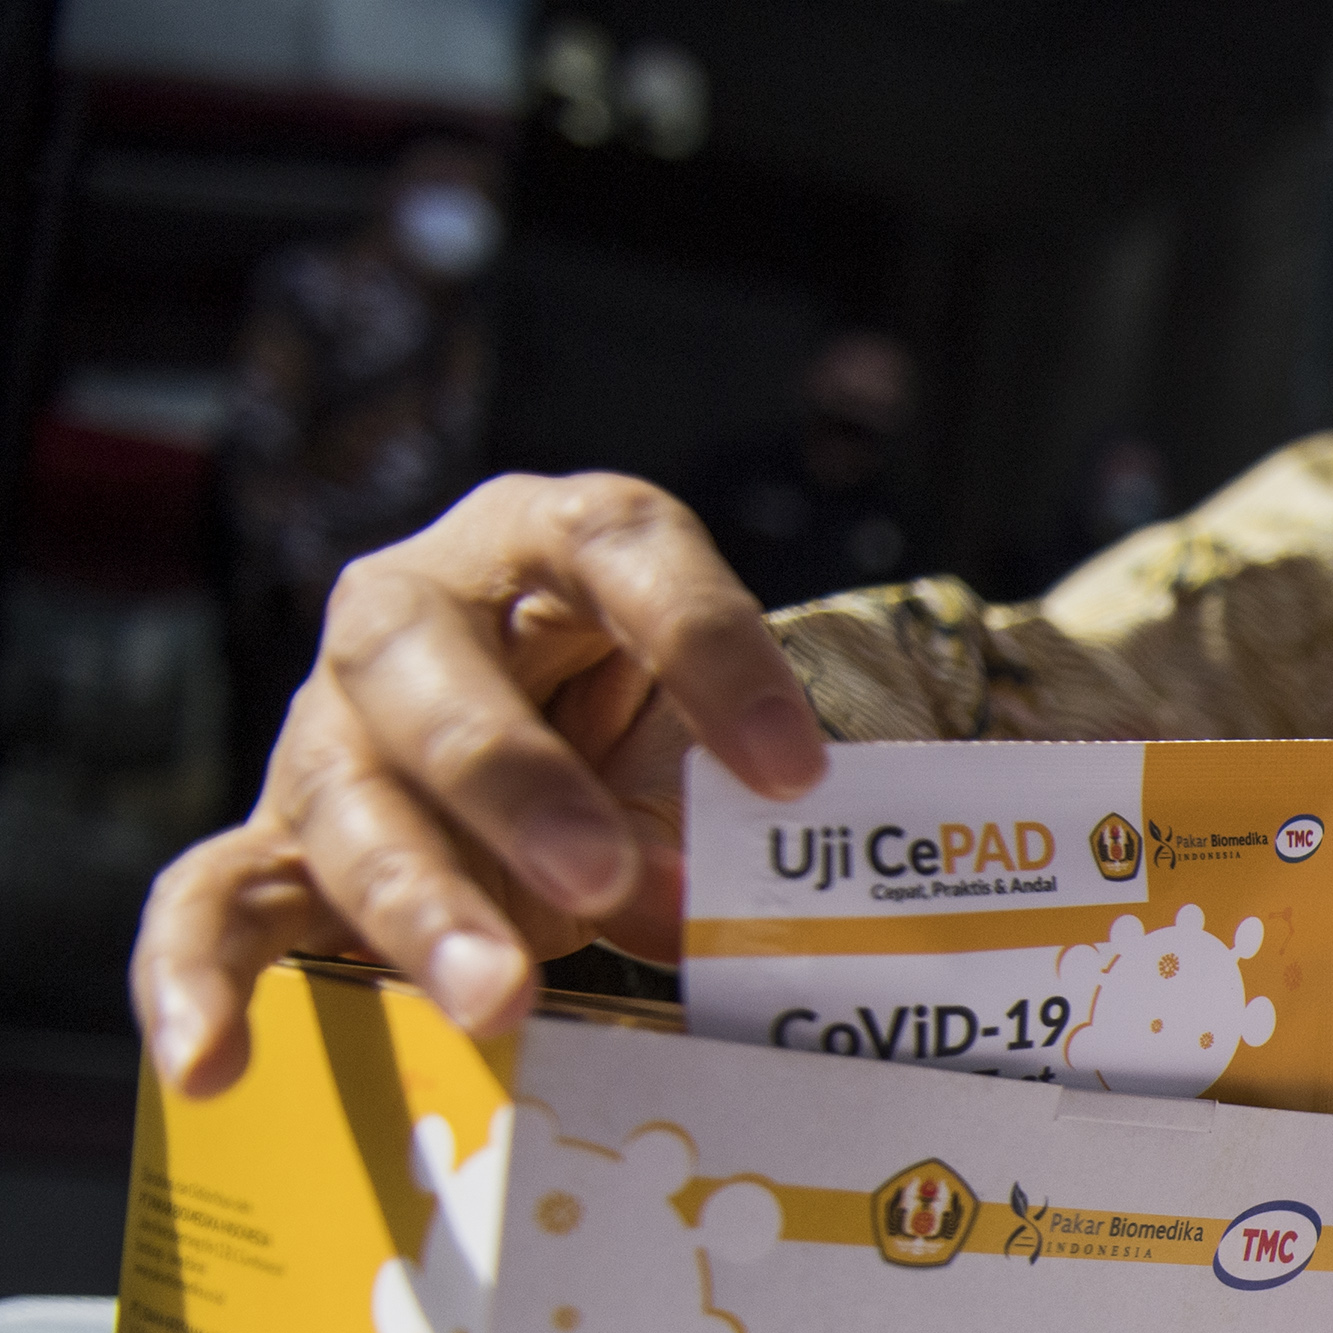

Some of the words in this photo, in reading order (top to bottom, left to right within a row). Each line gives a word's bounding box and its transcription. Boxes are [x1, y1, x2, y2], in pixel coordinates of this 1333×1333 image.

[1176, 835, 1207, 848] Pakar
[1211, 832, 1268, 847] Biomedika
[1286, 829, 1314, 848] TMC
[769, 826, 853, 890] Uji
[866, 821, 1055, 877] CePAD
[1178, 851, 1241, 861] INDONESIA
[932, 880, 991, 897] Praktis
[994, 879, 1006, 894] &
[1010, 875, 1057, 894] Andal
[770, 996, 1071, 1060] CoViD-19
[1050, 1213, 1105, 1236] Pakar
[1109, 1216, 1204, 1242] Biomedika
[1047, 1241, 1153, 1259] INDONESIA
[1243, 1228, 1298, 1263] TMC
